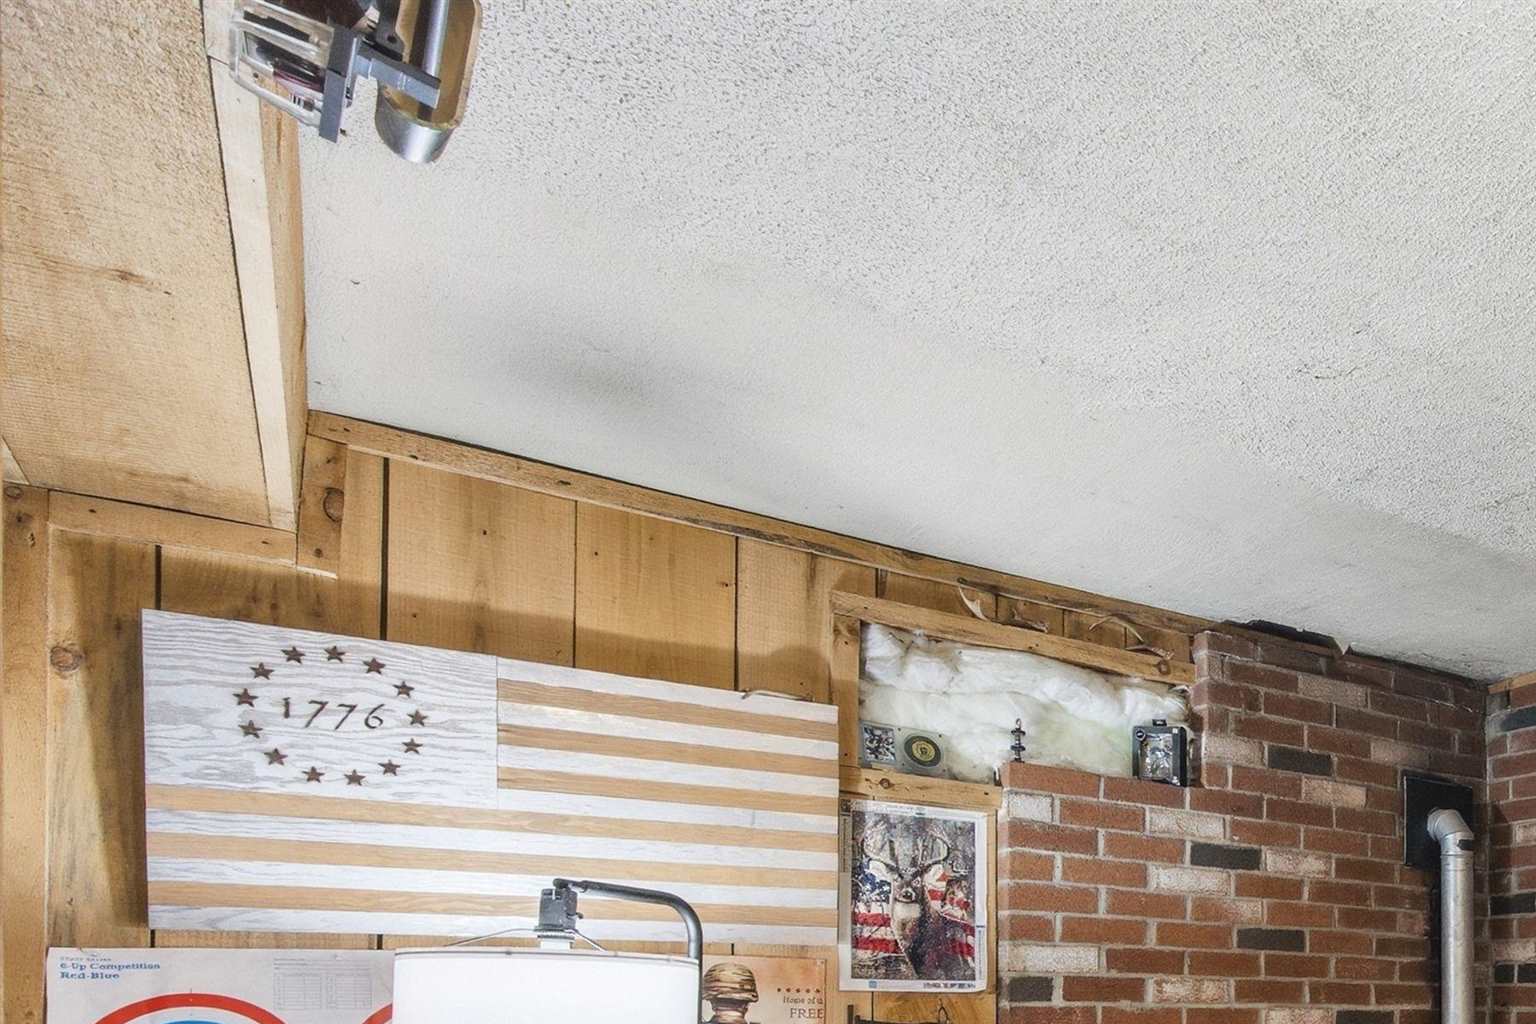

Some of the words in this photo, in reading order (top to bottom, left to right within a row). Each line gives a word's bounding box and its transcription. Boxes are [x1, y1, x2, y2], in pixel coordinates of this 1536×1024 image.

[282, 697, 385, 730] 1776
[89, 962, 161, 972] Competition
[60, 972, 120, 980] Red-Blue
[789, 1007, 825, 1019] FREE
